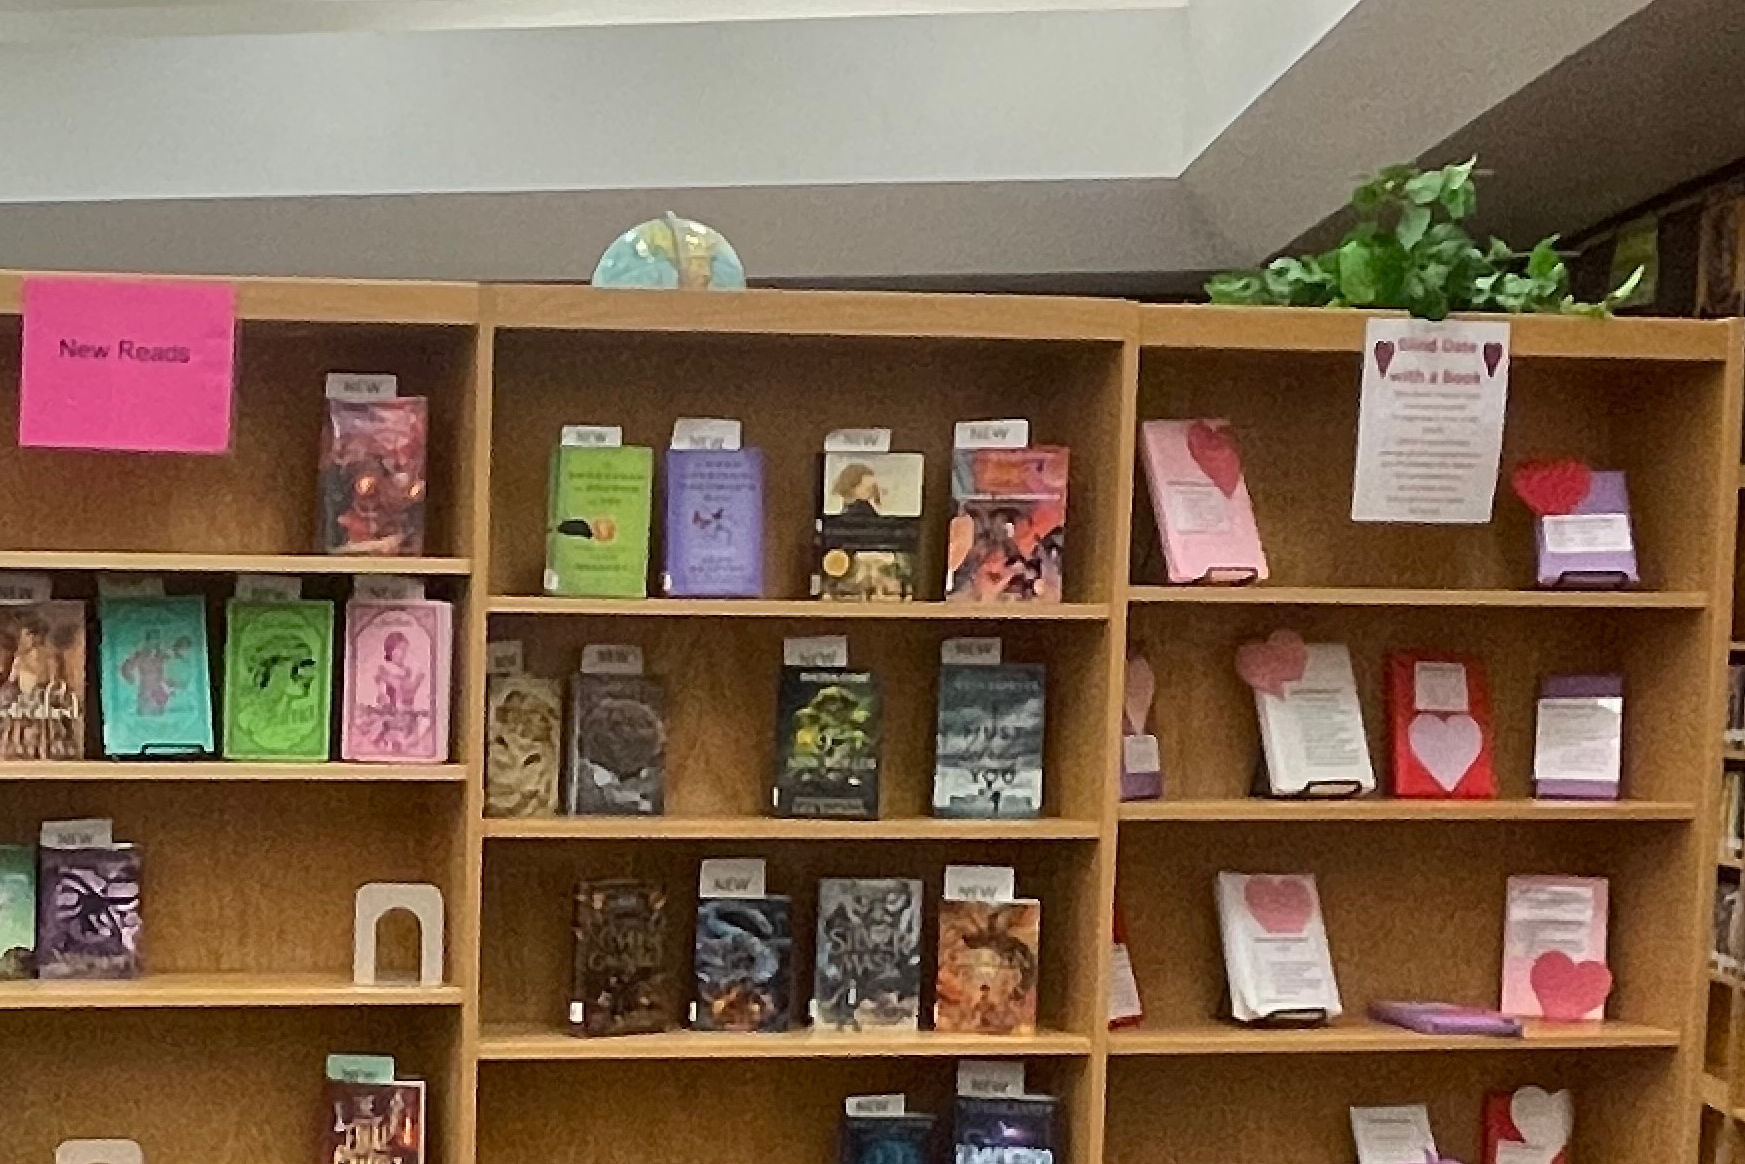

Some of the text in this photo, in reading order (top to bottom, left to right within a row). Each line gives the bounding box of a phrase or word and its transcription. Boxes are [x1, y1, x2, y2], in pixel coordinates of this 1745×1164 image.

[59, 339, 191, 364] New Reads
[1442, 338, 1477, 353] Date
[1443, 369, 1481, 384] Book
[713, 878, 751, 891] NEW
